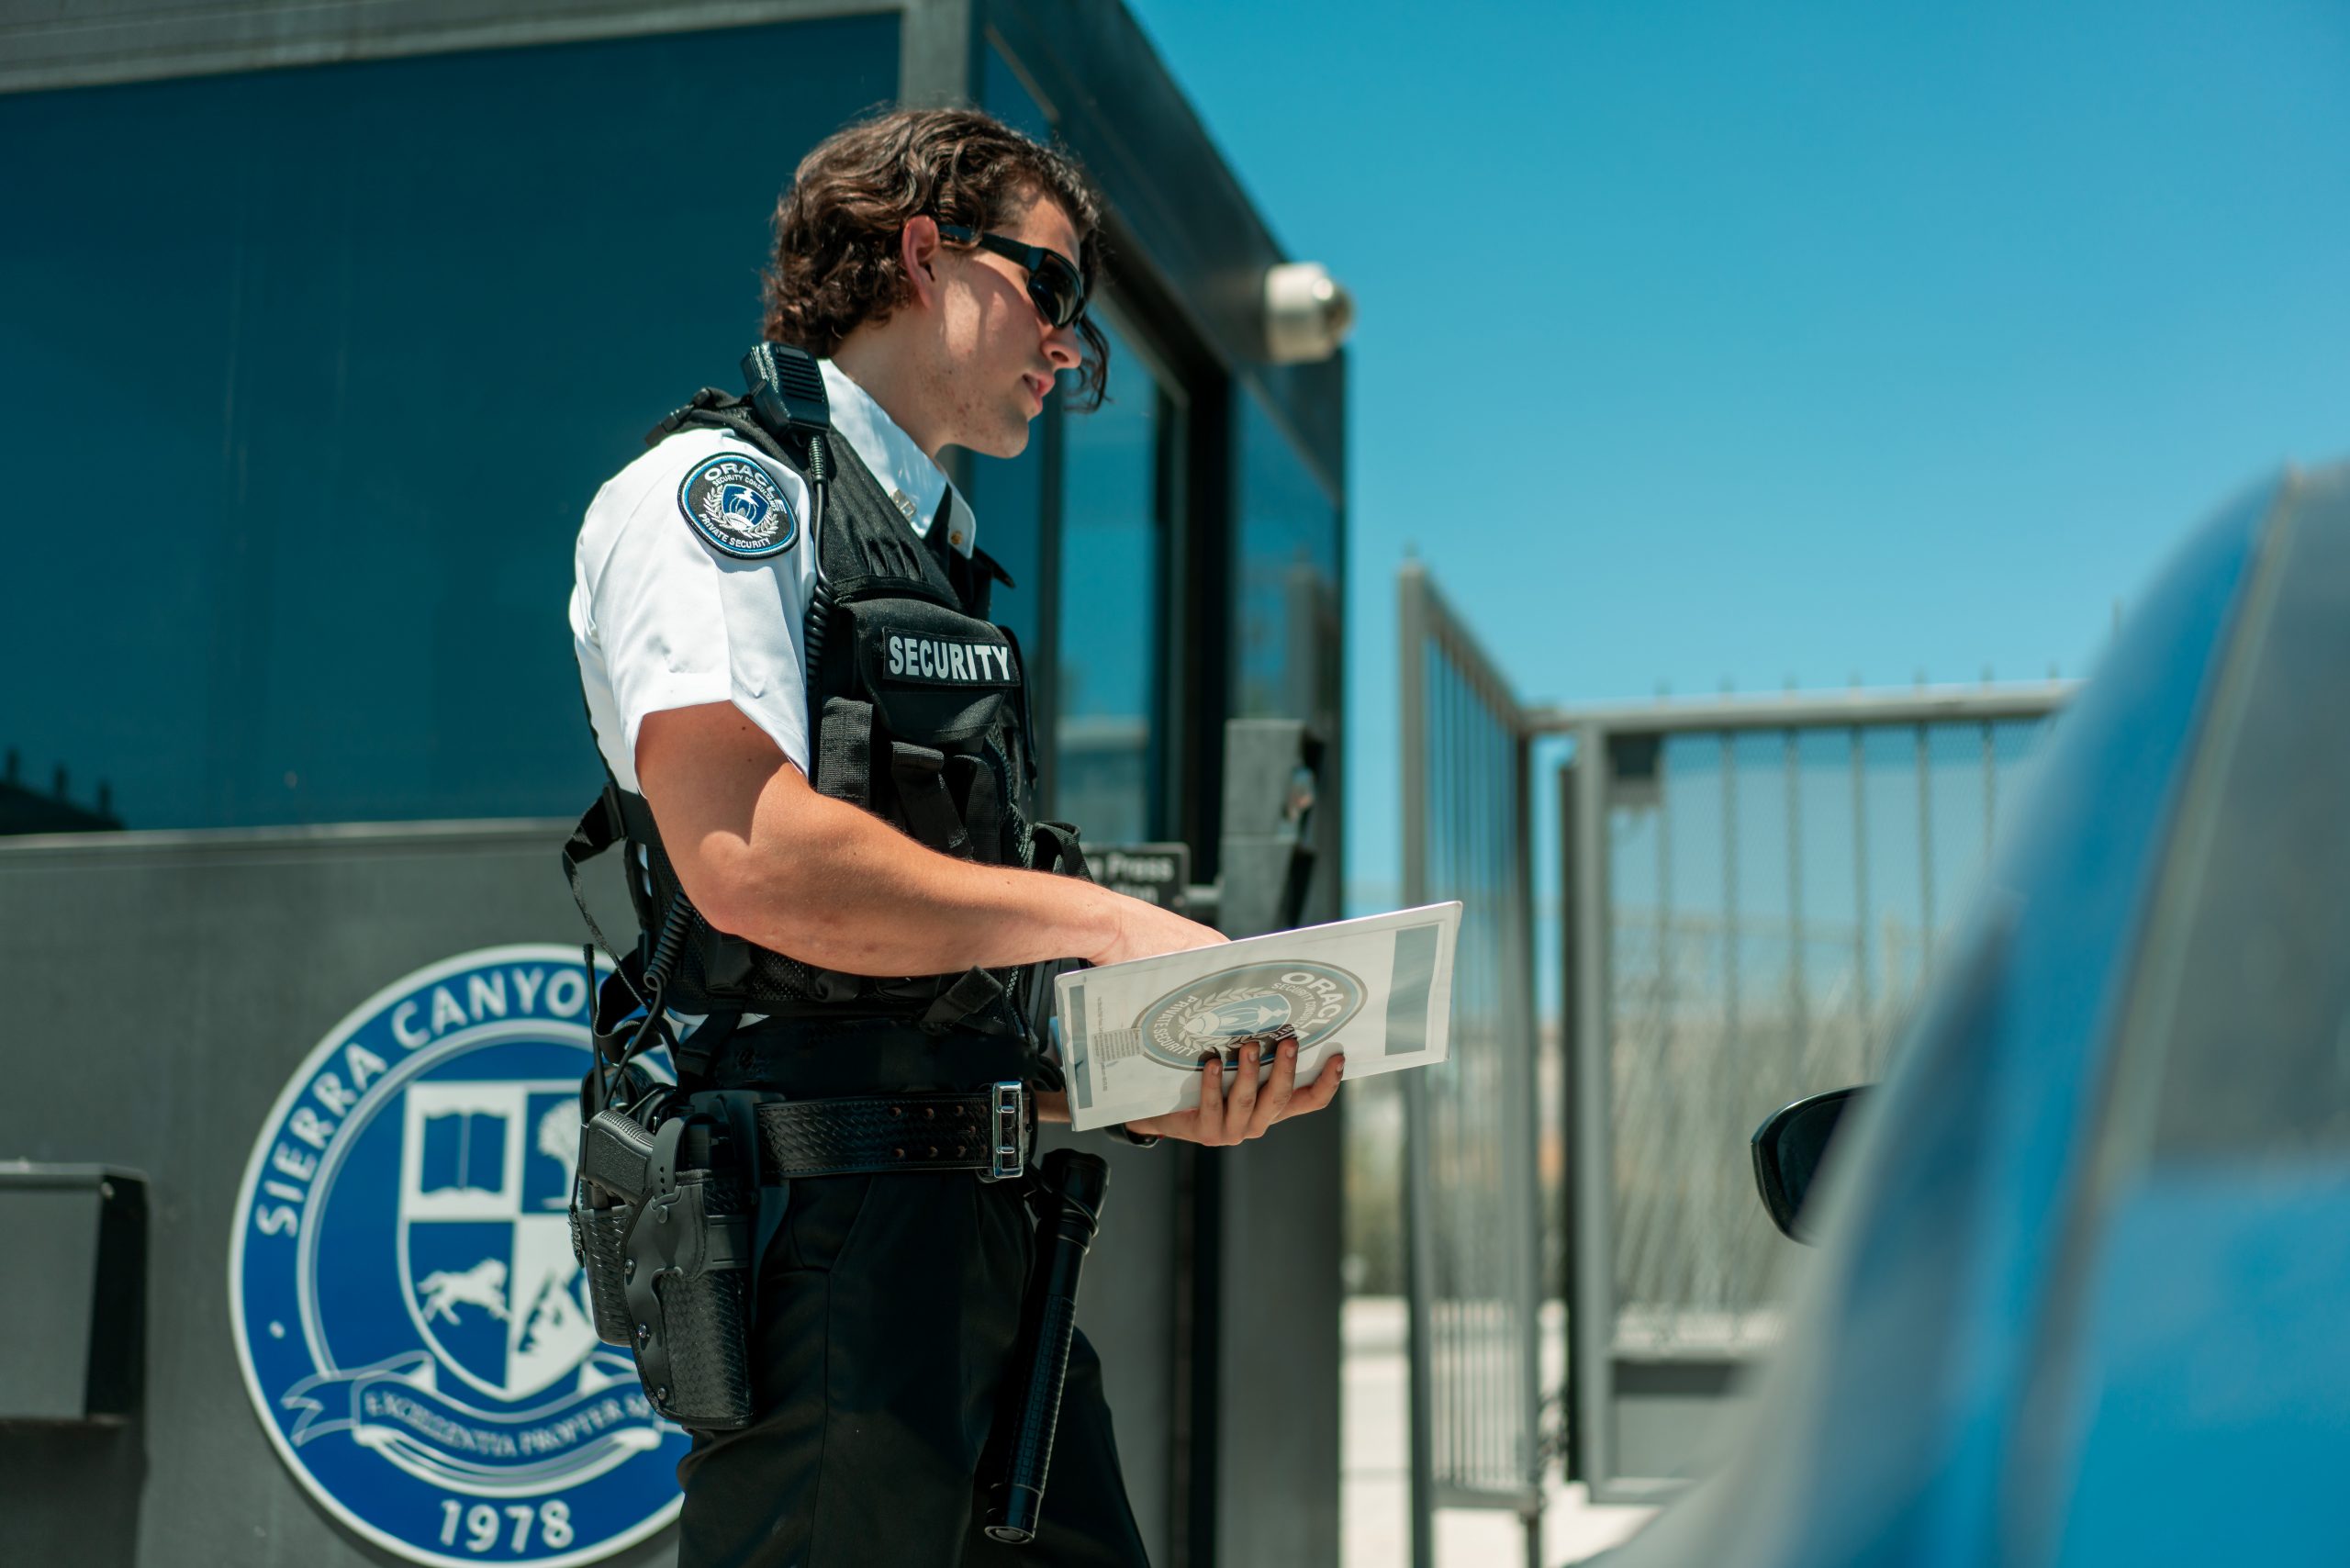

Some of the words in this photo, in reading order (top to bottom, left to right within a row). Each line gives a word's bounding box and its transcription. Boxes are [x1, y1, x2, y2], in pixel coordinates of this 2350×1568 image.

[704, 463, 787, 514] ORACLE
[712, 474, 744, 487] SECURITY
[699, 513, 730, 542] PRIVATE
[729, 537, 771, 549] SECURITY
[889, 635, 1010, 681] SECURITY
[1154, 995, 1198, 1027] PRIVATE
[1153, 1027, 1199, 1057] SECURITY
[255, 1043, 387, 1238] SIERRA
[391, 967, 599, 1049] CANYO
[439, 1498, 575, 1551] 1978
